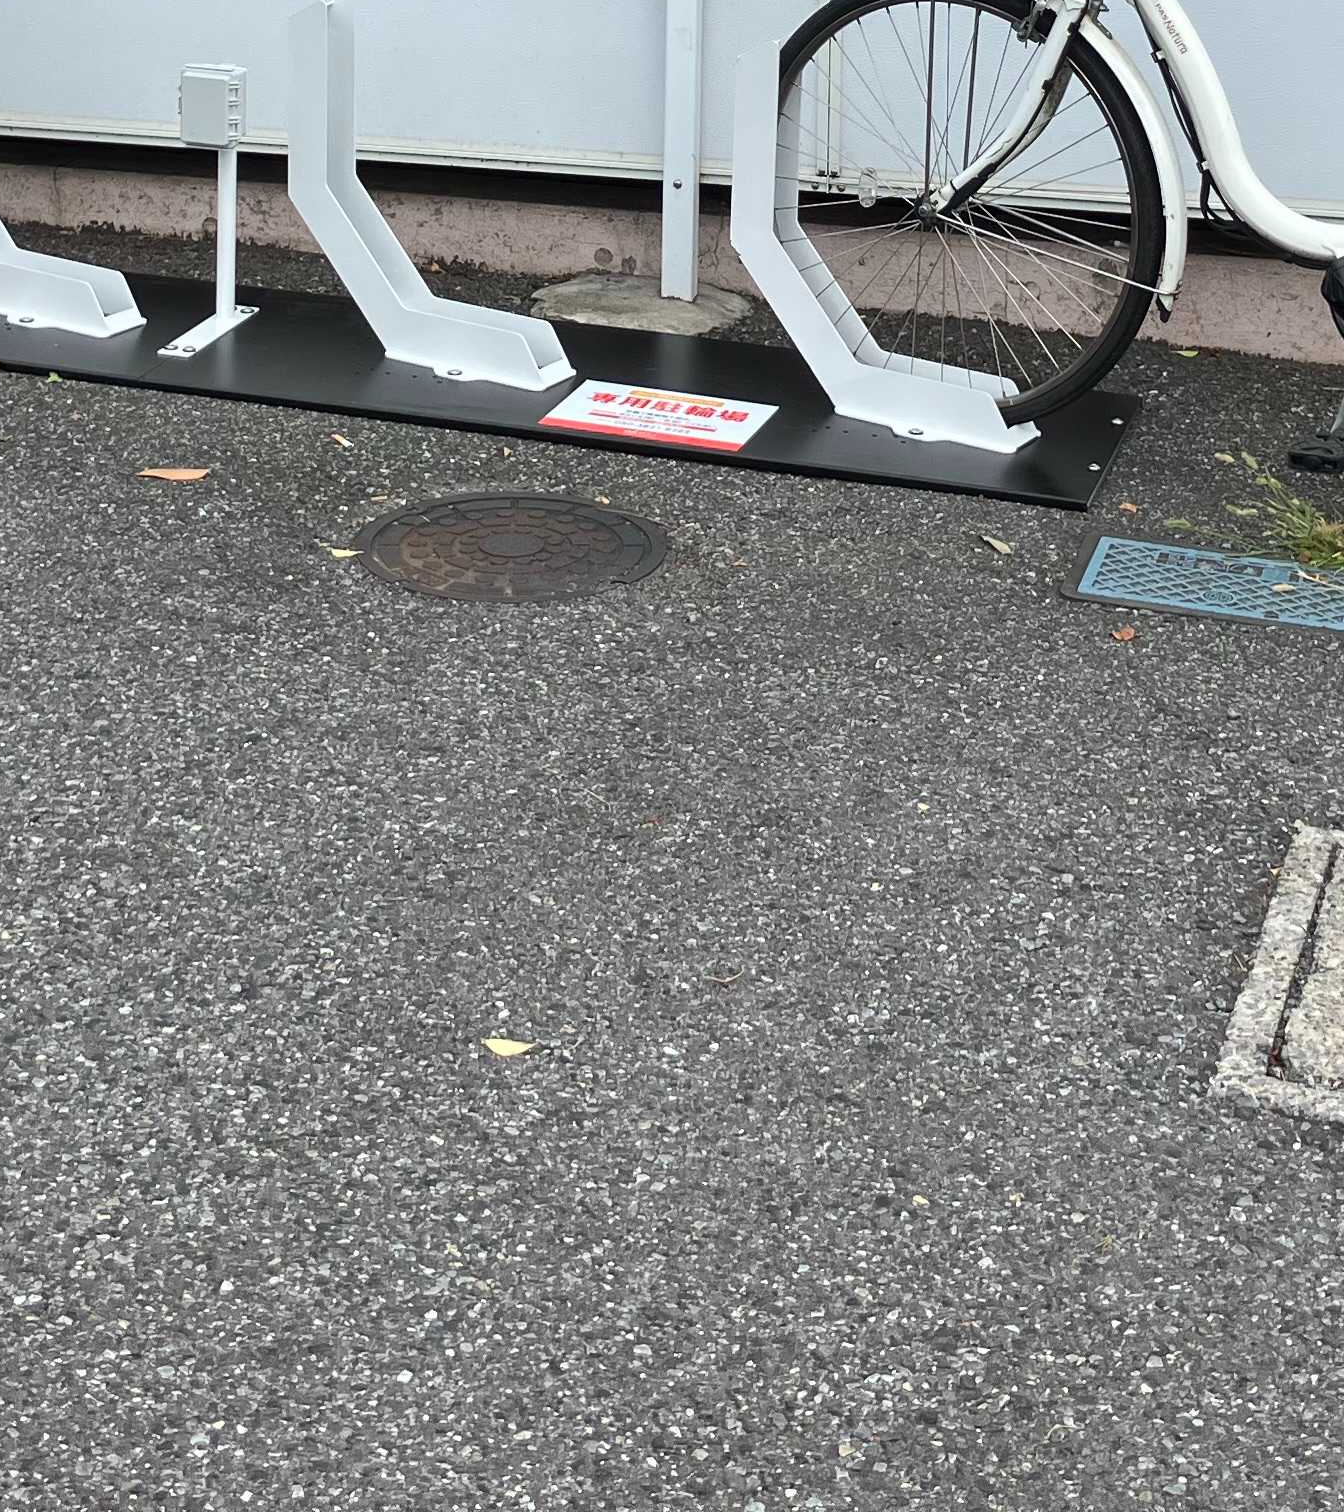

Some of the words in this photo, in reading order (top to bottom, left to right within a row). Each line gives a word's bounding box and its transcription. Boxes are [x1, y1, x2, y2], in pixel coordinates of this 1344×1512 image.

[1164, 20, 1188, 55] Natura
[587, 392, 750, 423] 専用駐輪場
